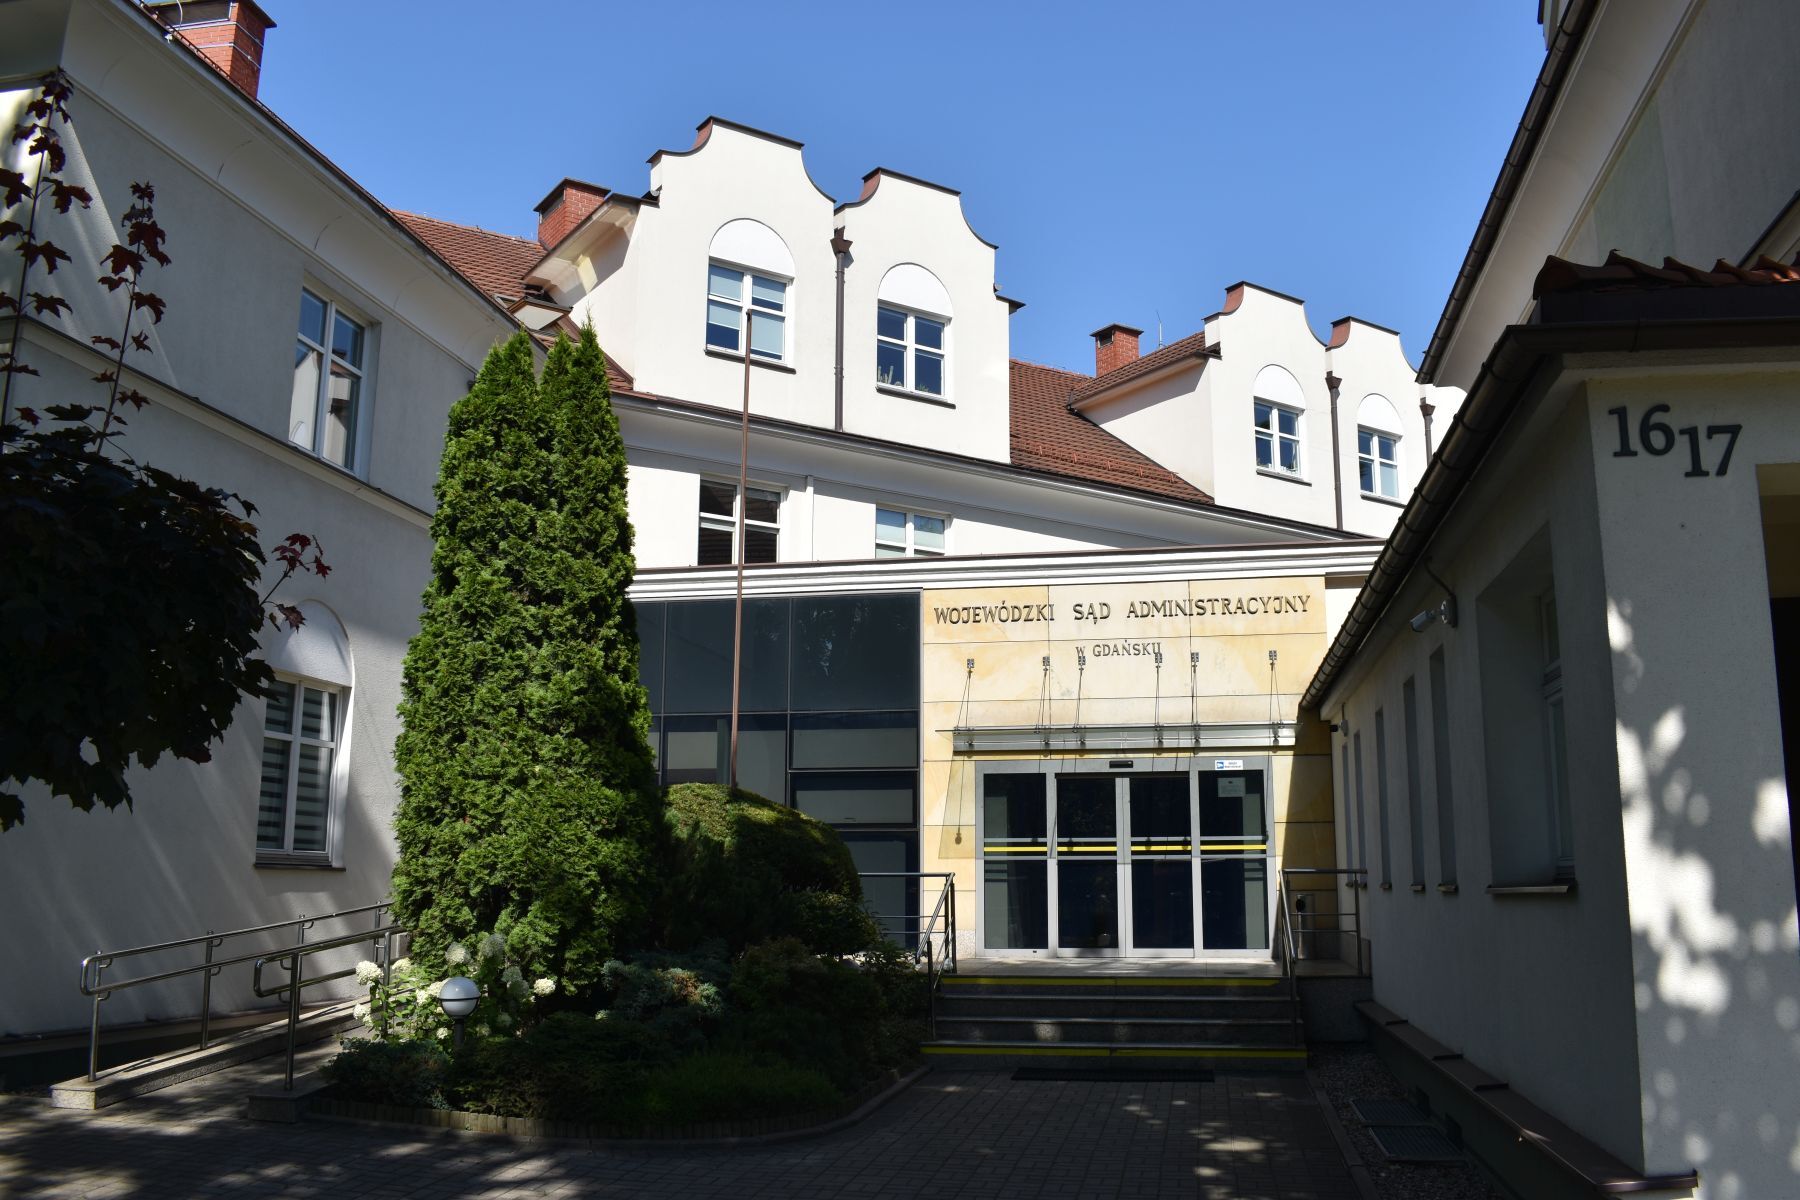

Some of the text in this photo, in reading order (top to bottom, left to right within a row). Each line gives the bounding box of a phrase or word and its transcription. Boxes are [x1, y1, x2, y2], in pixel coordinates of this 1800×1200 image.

[933, 595, 1311, 625] WOJEWÓDZKI SĄD ADMINISTRACYJNY
[1092, 639, 1162, 657] GDAŃSKU
